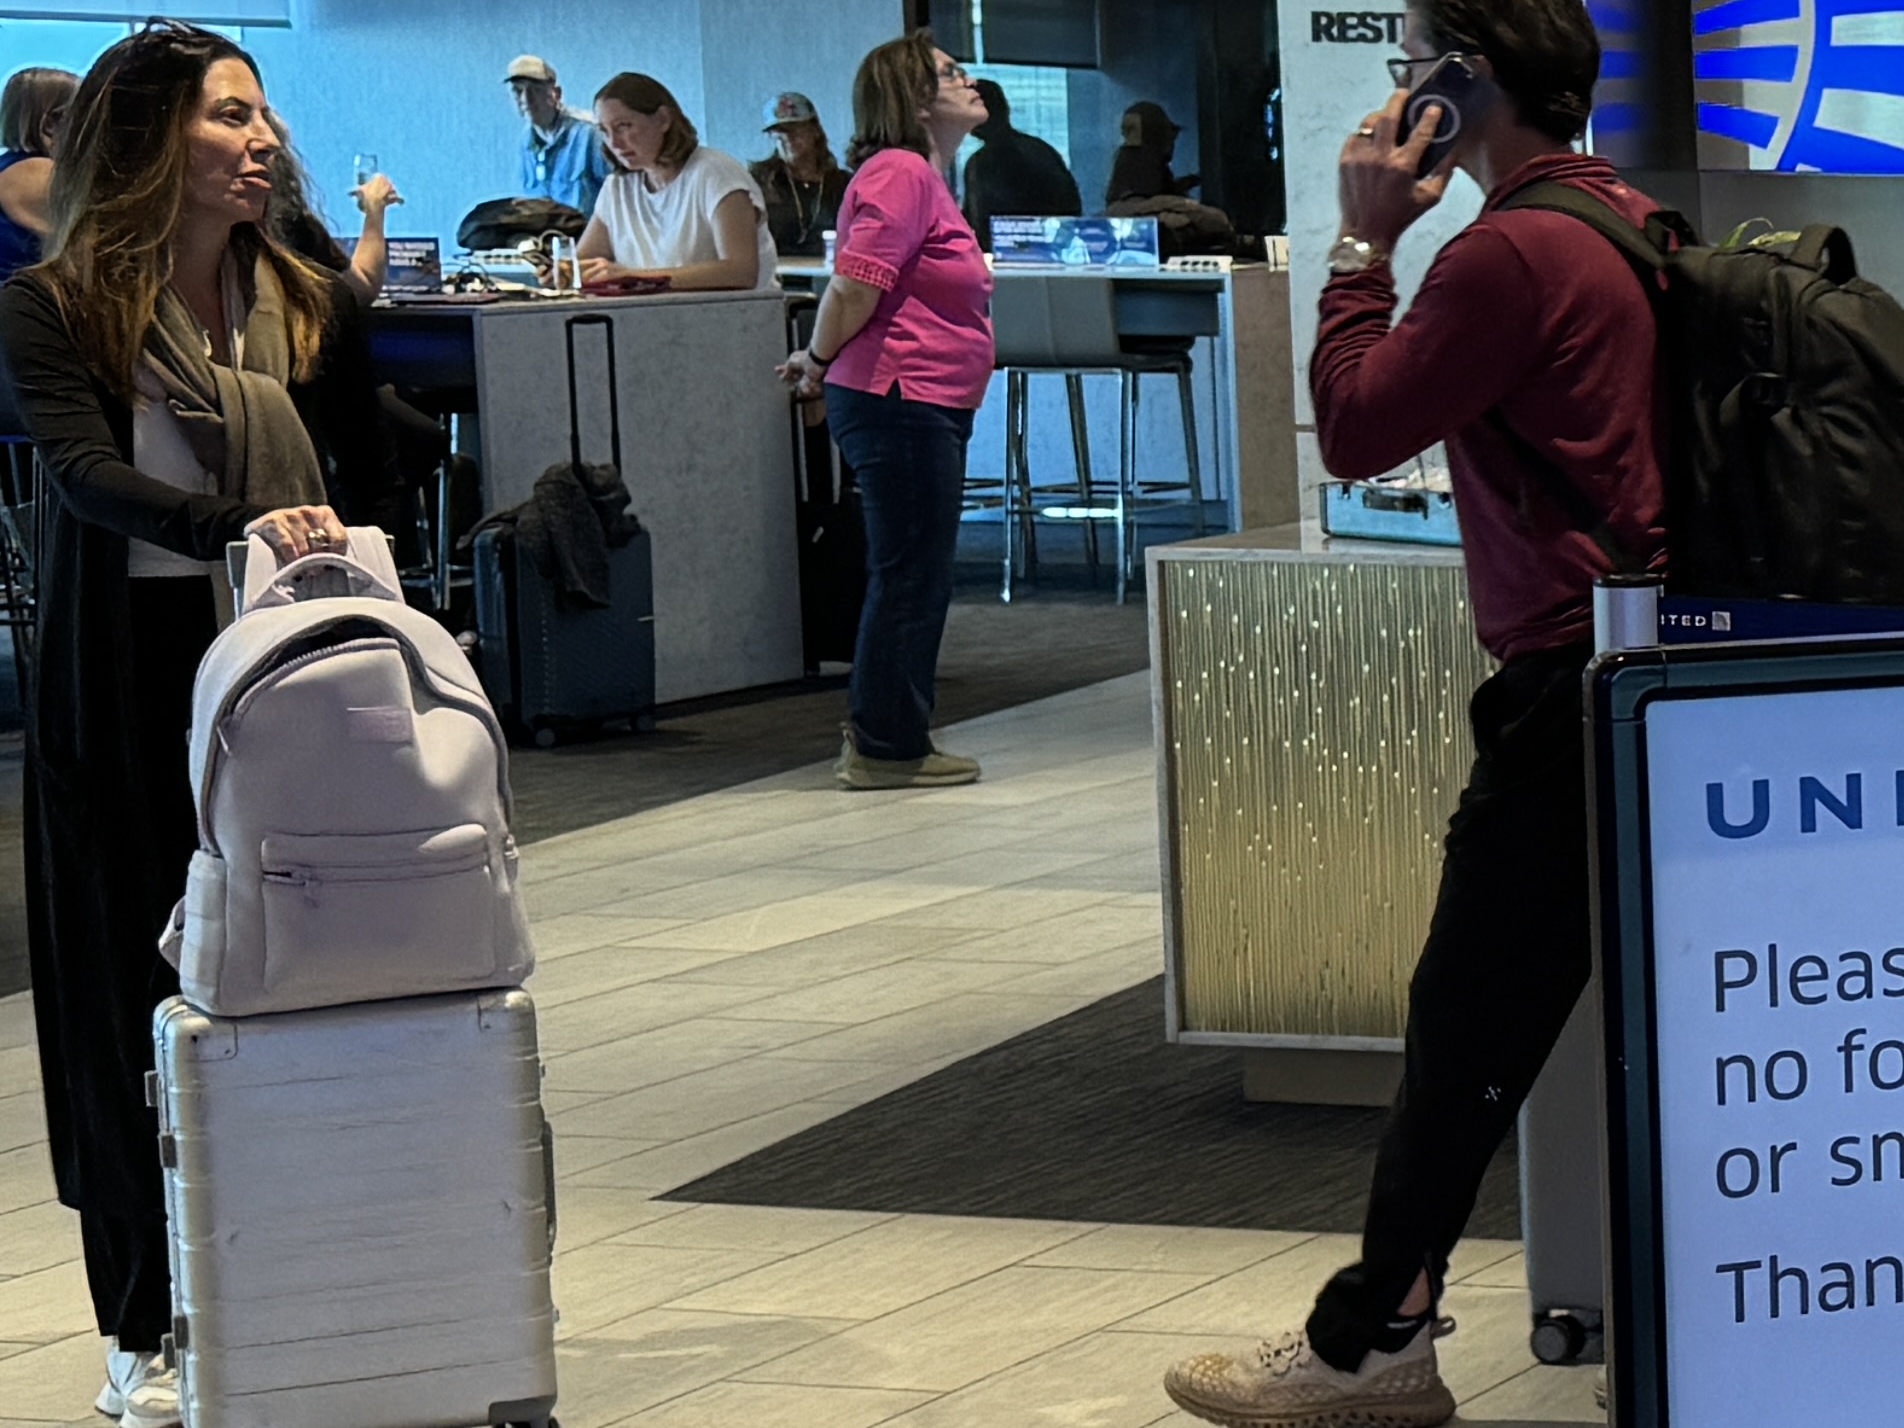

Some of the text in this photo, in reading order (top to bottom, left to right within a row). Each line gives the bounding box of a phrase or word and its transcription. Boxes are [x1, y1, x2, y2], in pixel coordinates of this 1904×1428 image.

[1311, 11, 1405, 43] REST
[1661, 614, 1706, 627] ITED
[1716, 1046, 1808, 1106] no
[1717, 1143, 1799, 1199] or
